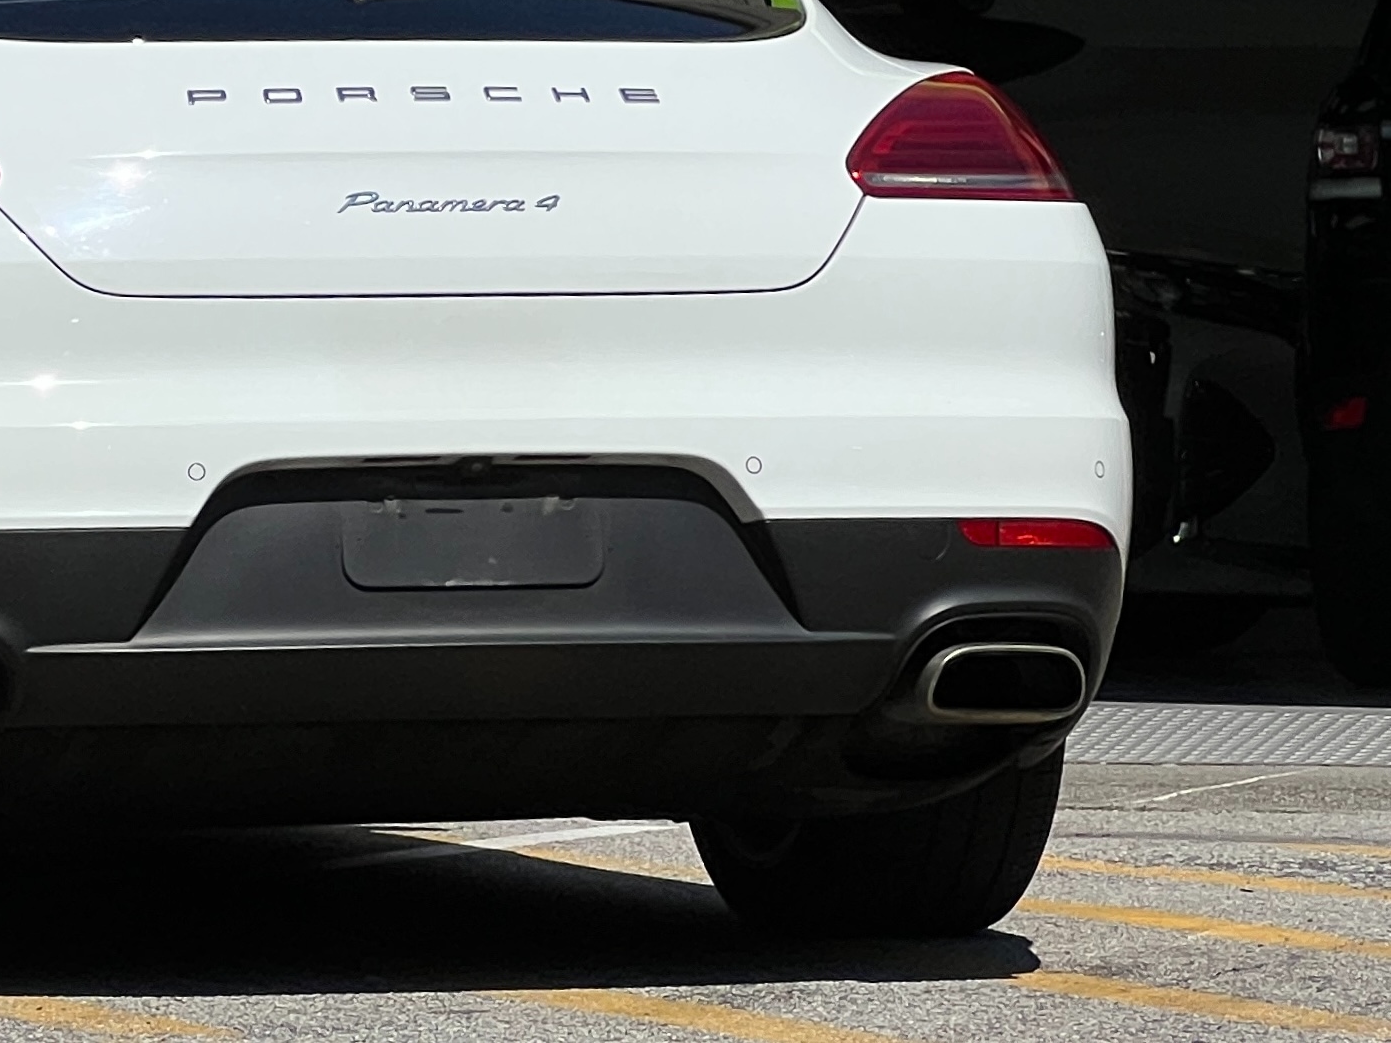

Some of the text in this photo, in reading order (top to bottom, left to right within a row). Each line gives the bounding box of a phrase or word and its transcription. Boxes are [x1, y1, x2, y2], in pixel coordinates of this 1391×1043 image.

[185, 85, 662, 106] PORSCHE
[336, 190, 562, 214] Panamera 4
